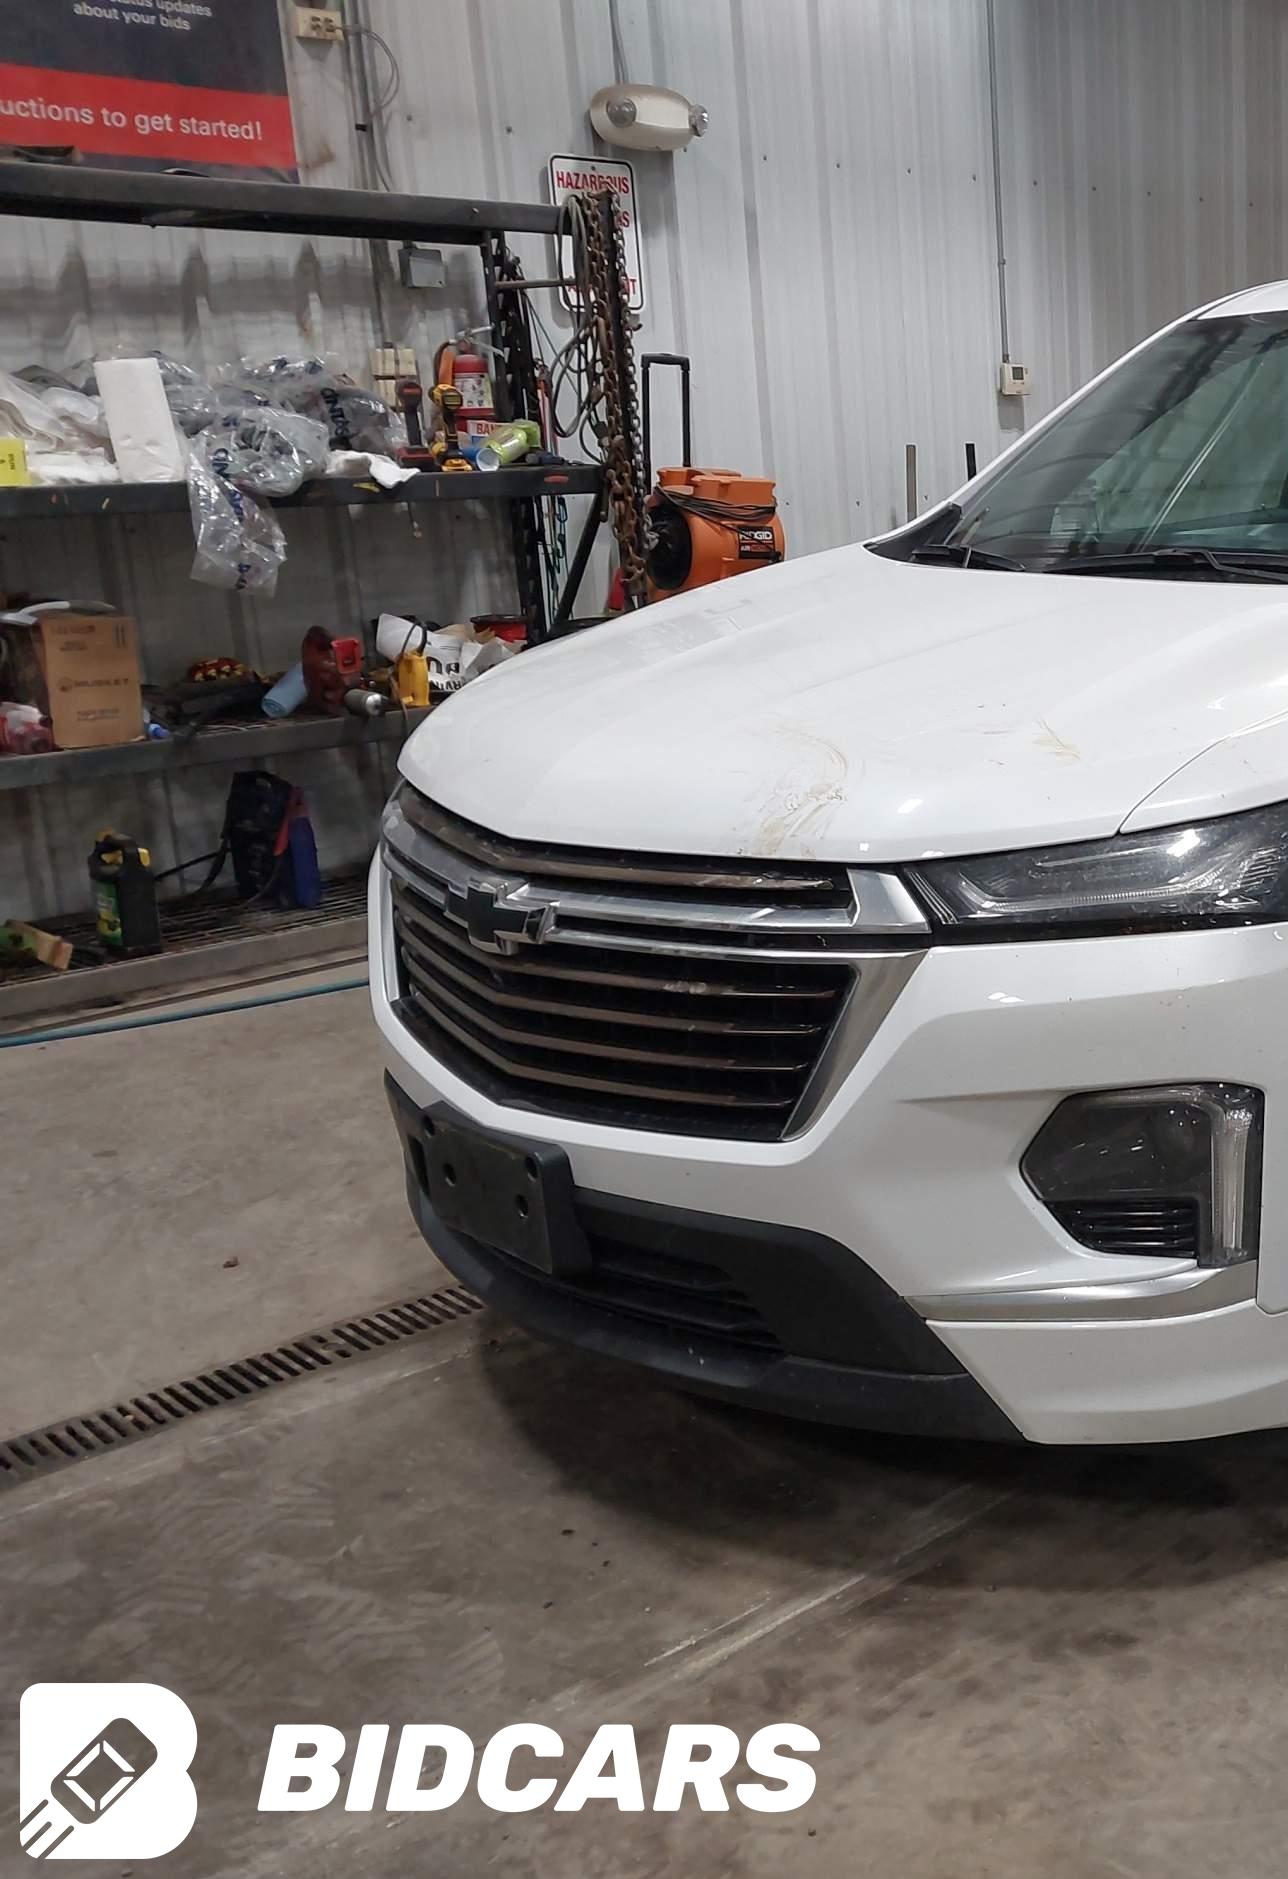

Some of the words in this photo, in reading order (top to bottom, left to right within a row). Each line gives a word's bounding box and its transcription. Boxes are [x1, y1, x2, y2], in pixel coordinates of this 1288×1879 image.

[73, 2, 119, 20] about
[122, 11, 157, 25] your
[159, 13, 191, 30] bids
[155, 0, 213, 17] updates
[100, 106, 127, 128] to
[134, 113, 174, 135] get
[179, 116, 262, 141] started!
